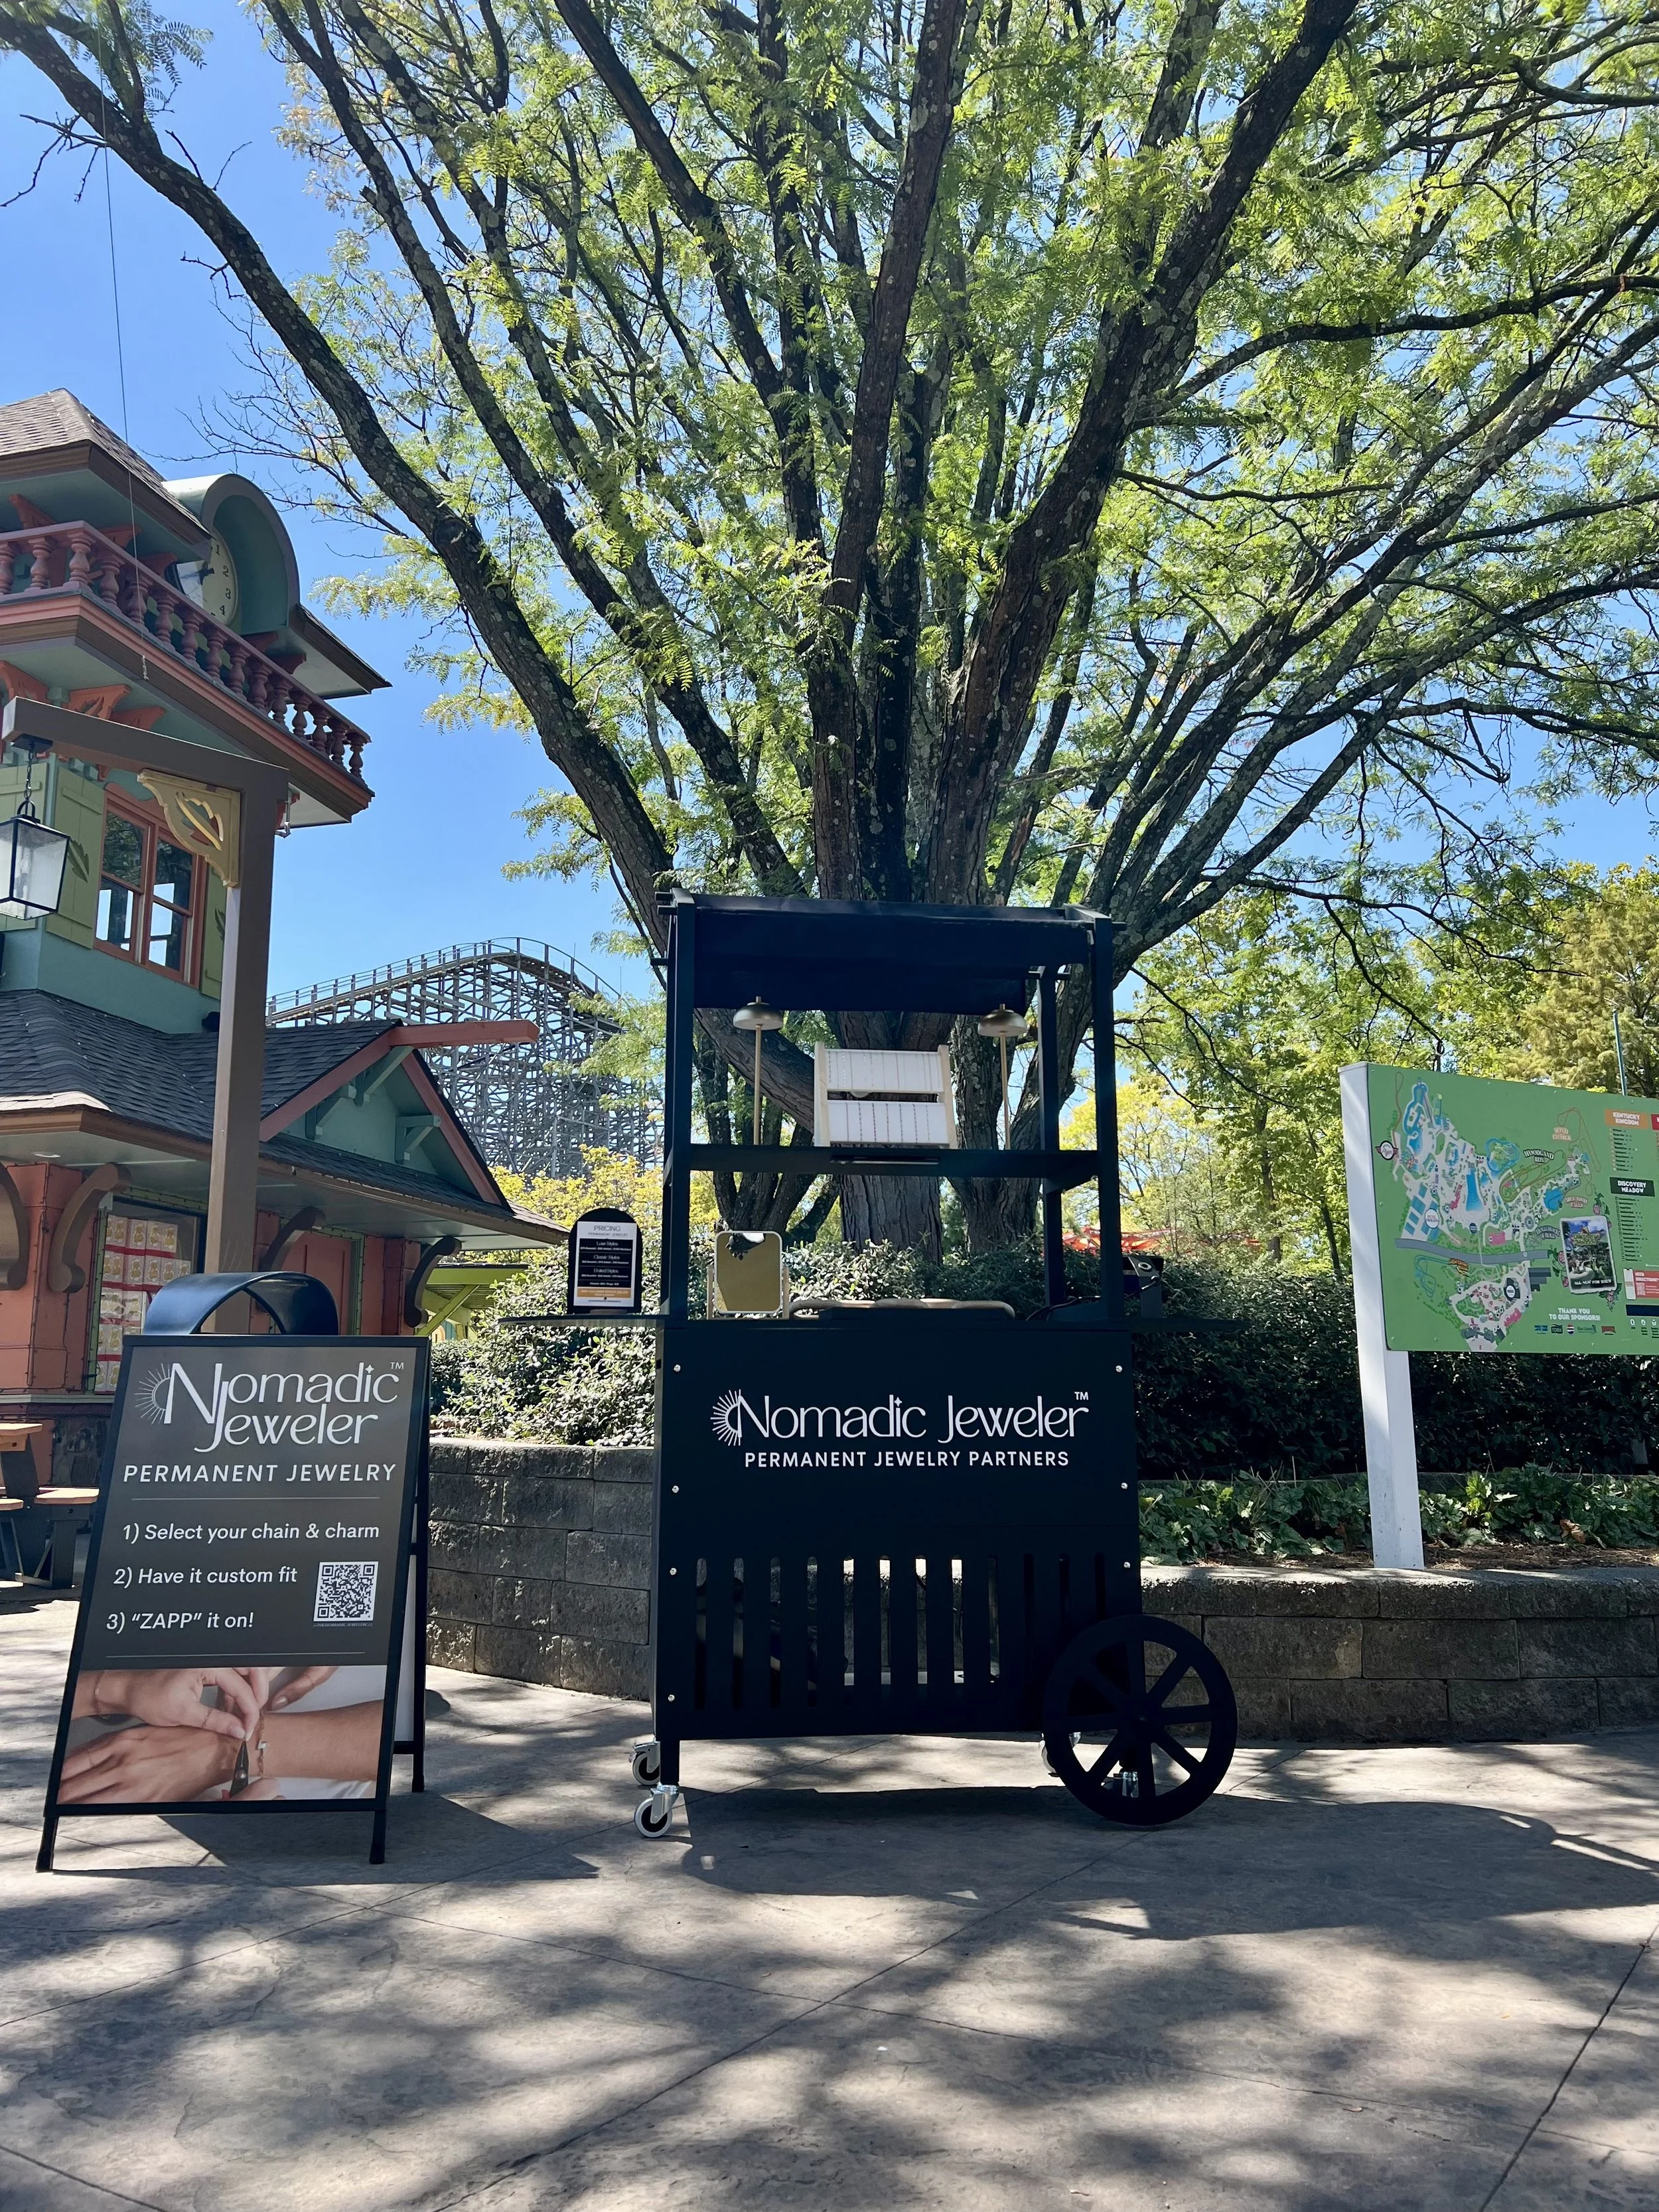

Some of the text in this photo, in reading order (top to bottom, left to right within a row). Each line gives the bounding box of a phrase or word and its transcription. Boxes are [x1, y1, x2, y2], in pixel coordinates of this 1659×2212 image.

[1617, 1180, 1646, 1189] DISCOVERY
[163, 1363, 399, 1424] Nomadic
[194, 1381, 378, 1453] Jeweler
[737, 1394, 926, 1438] Nomadic
[938, 1395, 1089, 1444] Jeweler
[745, 1451, 1069, 1468] PERMANENT JEWELRY PARTNERS
[123, 1463, 396, 1483] PERMANENT JEWELRY
[122, 1522, 380, 1544] 1) Select your chain & charm
[113, 1566, 298, 1589] 2) Have it custom fit
[106, 1612, 125, 1634] 3)
[207, 1612, 219, 1629] it
[224, 1612, 253, 1629] on!
